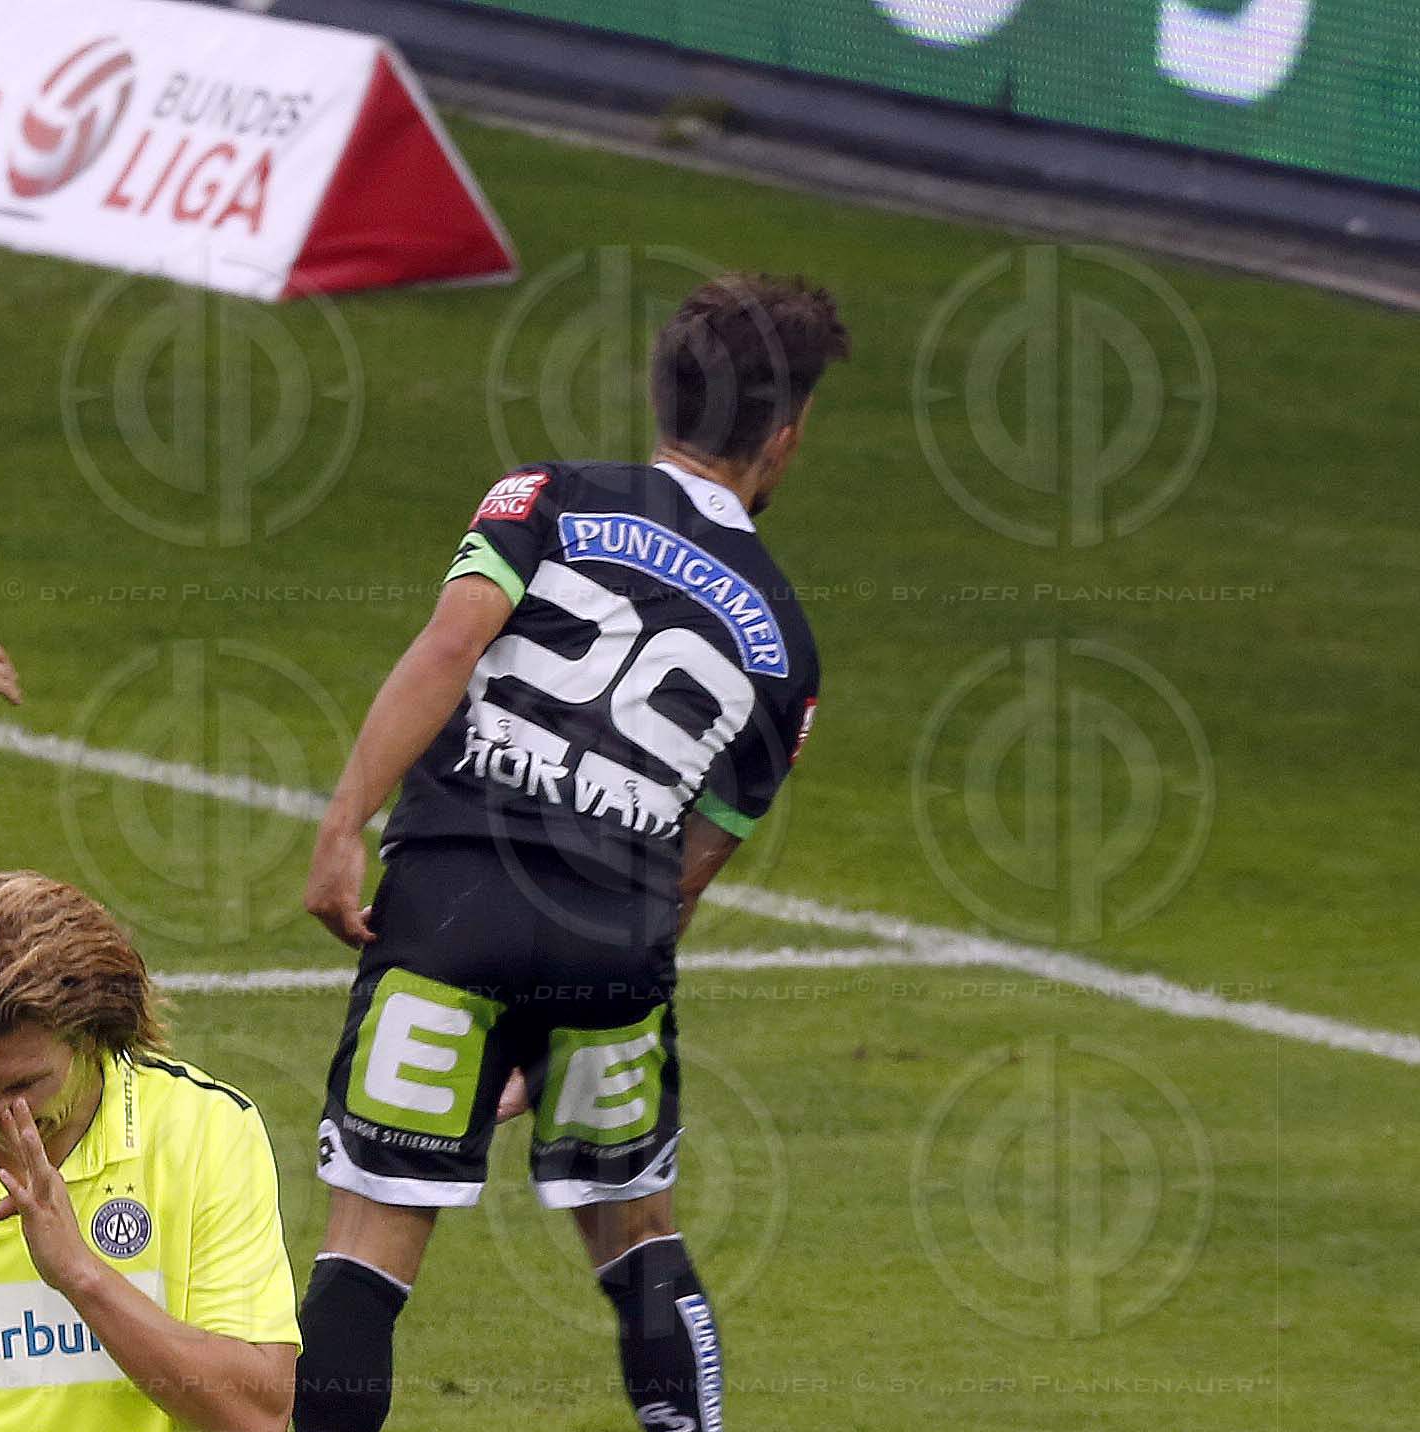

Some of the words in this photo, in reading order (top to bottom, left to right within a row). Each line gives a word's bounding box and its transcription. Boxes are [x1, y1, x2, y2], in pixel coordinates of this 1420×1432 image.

[153, 71, 312, 138] BUNDES
[101, 130, 274, 237] LIGA
[573, 518, 783, 667] PUNTIGAMER
[364, 992, 473, 1114] E
[554, 1032, 656, 1129] E
